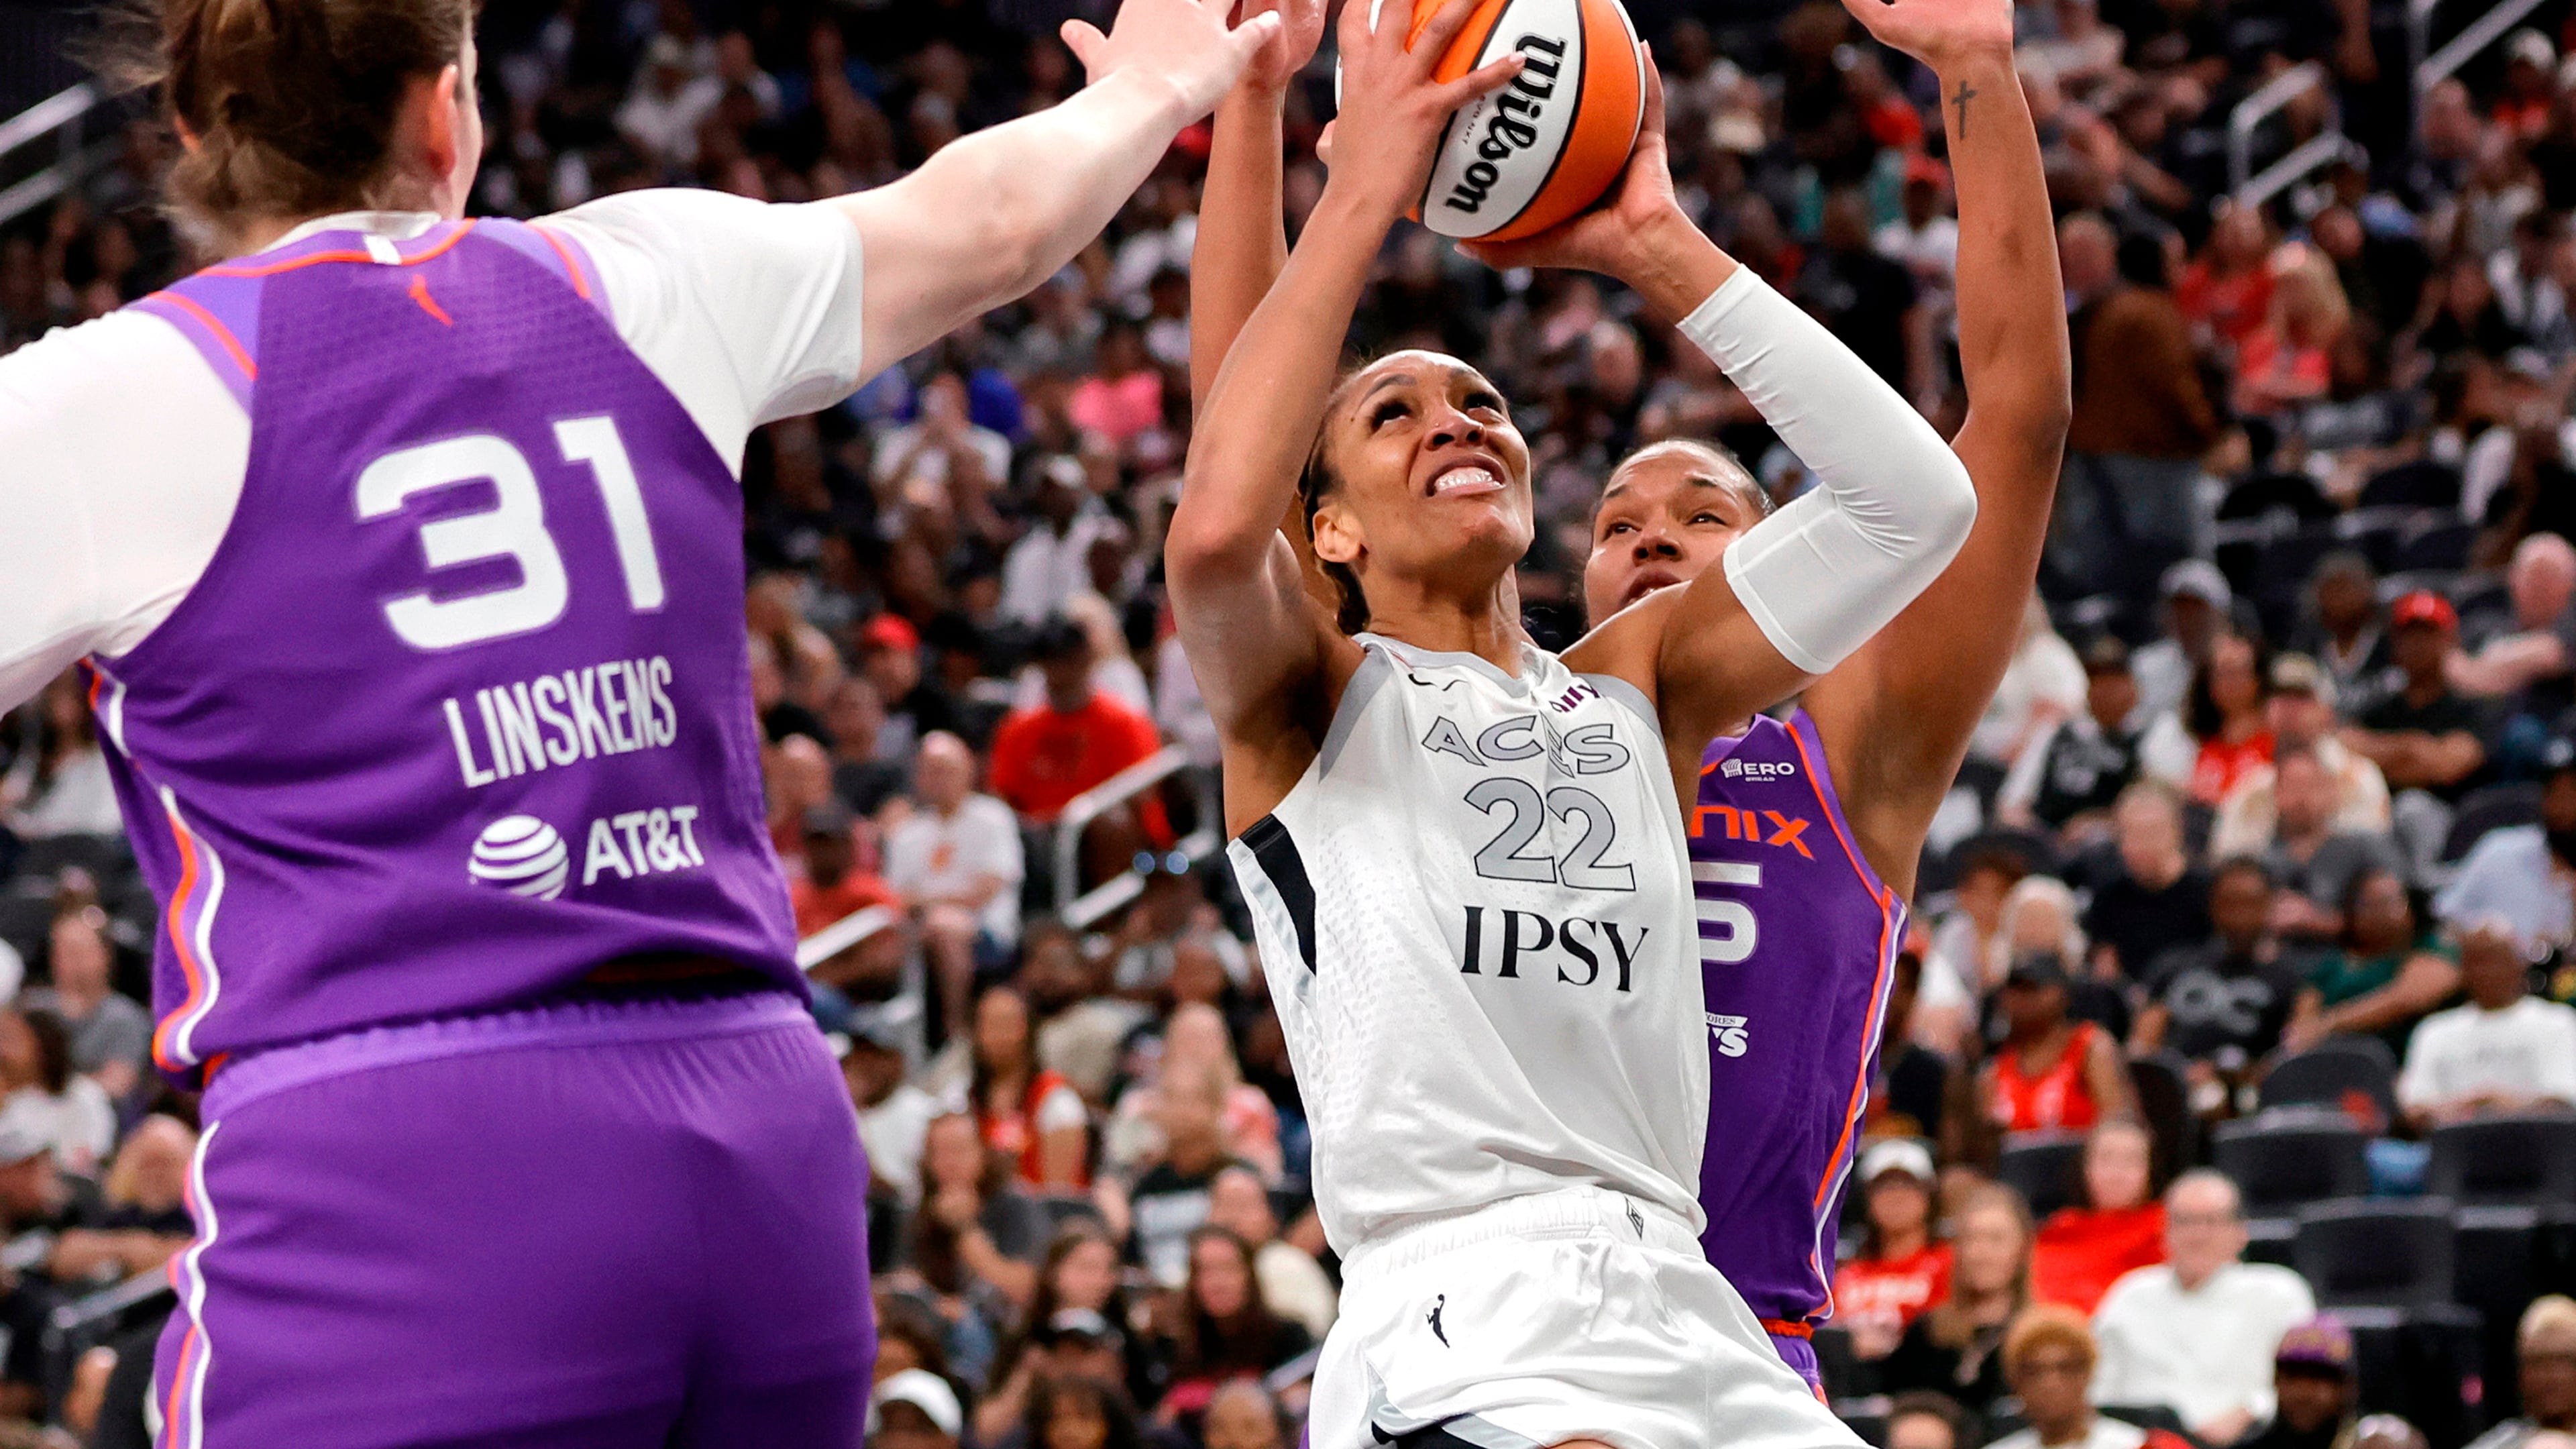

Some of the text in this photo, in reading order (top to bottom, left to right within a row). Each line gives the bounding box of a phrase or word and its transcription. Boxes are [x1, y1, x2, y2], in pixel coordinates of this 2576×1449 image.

[1444, 32, 1567, 213] Wilson
[356, 417, 663, 649] 31
[443, 655, 677, 788] LINSKENS
[1421, 709, 1630, 779] ACES
[583, 806, 704, 885] AT&T
[1463, 777, 1636, 892] 22
[1460, 906, 1650, 993] IPSY
[1690, 861, 1762, 962] 5
[1706, 1014, 1736, 1024] ORES
